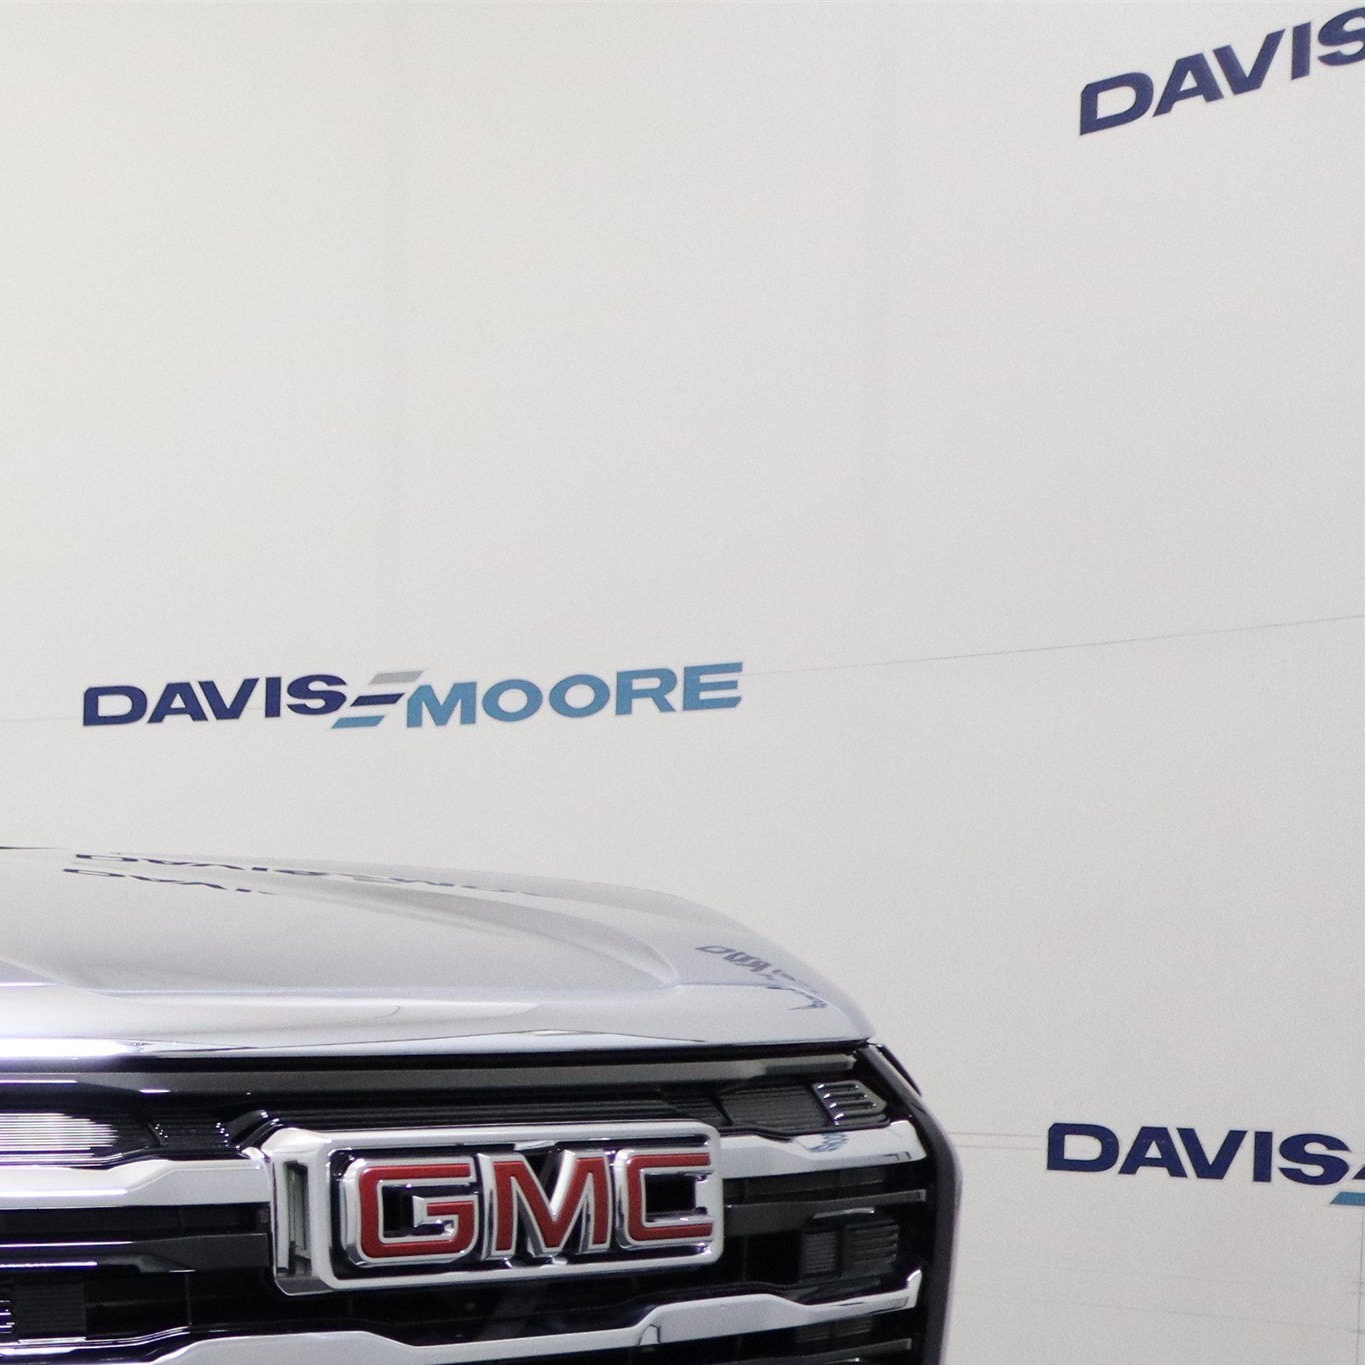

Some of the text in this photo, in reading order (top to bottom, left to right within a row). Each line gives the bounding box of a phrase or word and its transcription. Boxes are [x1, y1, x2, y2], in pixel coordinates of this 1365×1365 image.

[1079, 6, 1365, 136] DAVIS
[82, 661, 744, 729] DAVIS MOORE
[1046, 1121, 1352, 1186] DAVIS
[342, 1149, 715, 1268] GMC
